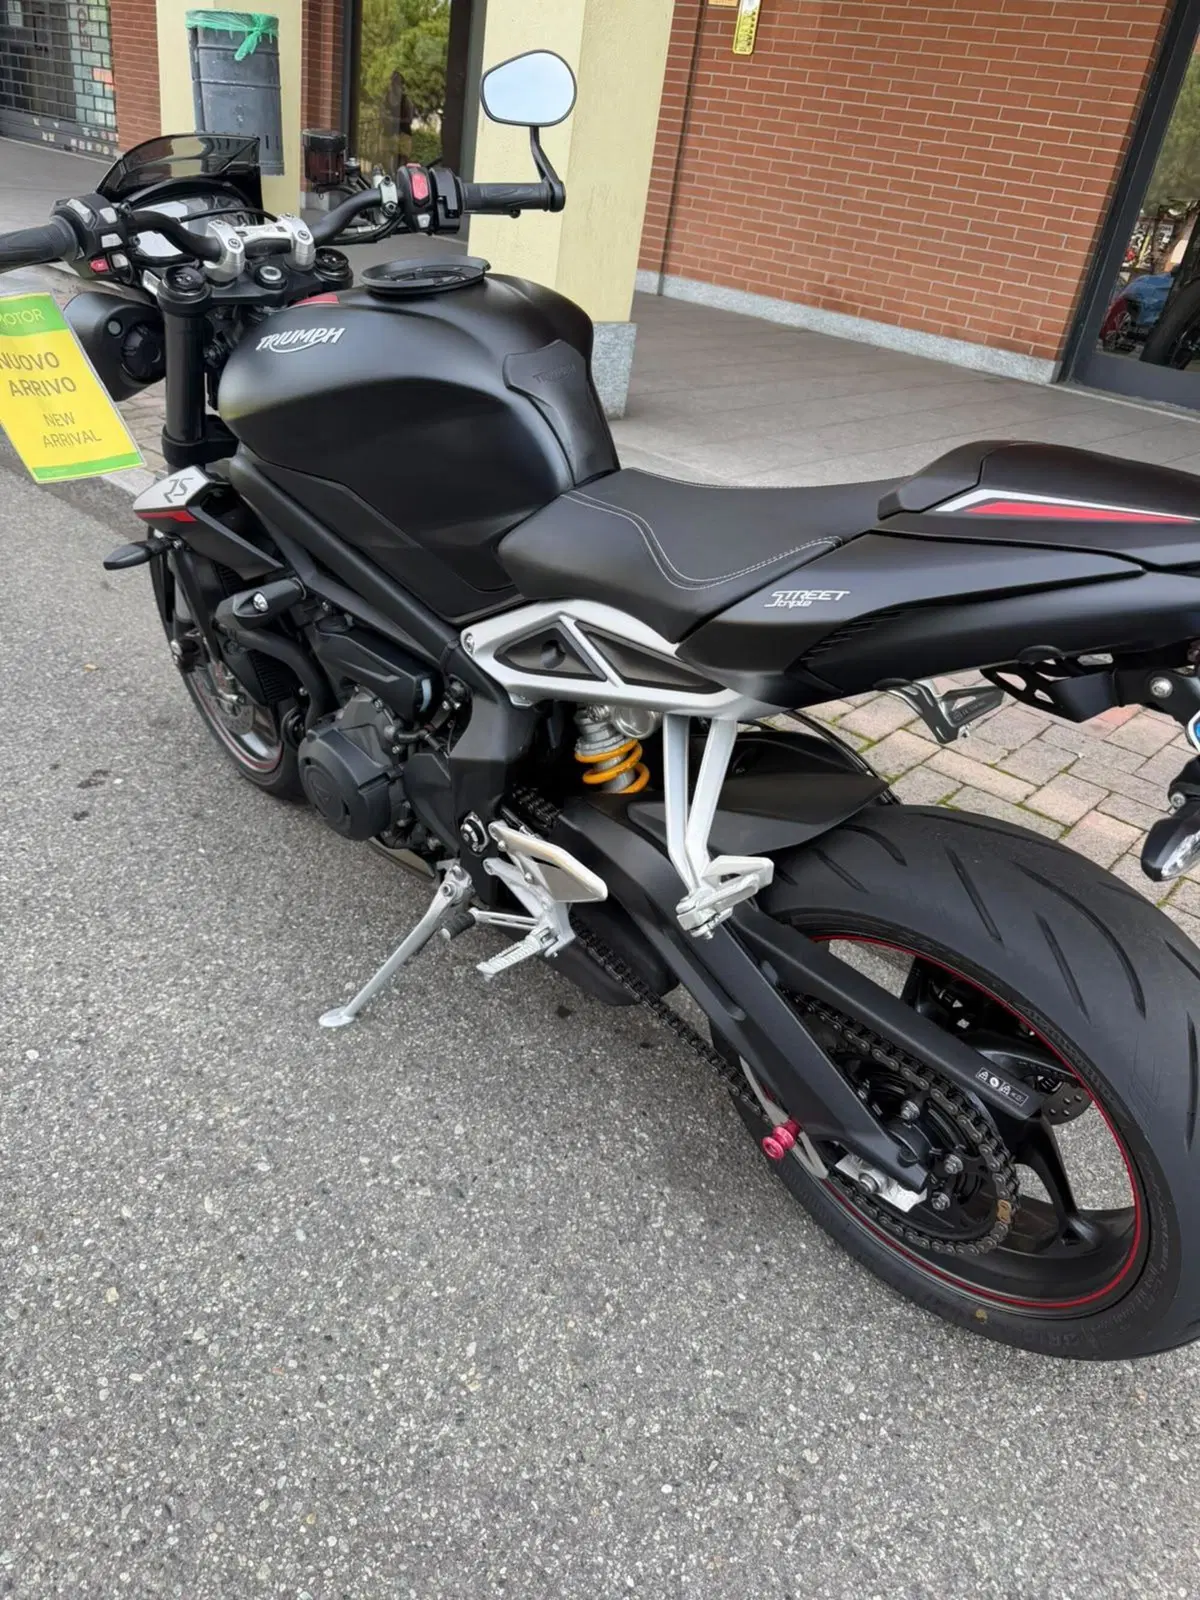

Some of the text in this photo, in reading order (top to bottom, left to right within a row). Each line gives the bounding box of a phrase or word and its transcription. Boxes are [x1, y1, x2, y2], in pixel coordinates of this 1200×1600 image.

[255, 327, 346, 353] TRIUMPH
[0, 351, 60, 371] NUOVO
[8, 376, 77, 397] ARRIVO
[42, 411, 76, 427] NEW
[42, 429, 103, 448] ARRIVAL
[163, 477, 195, 504] RS
[766, 590, 851, 605] STREET
